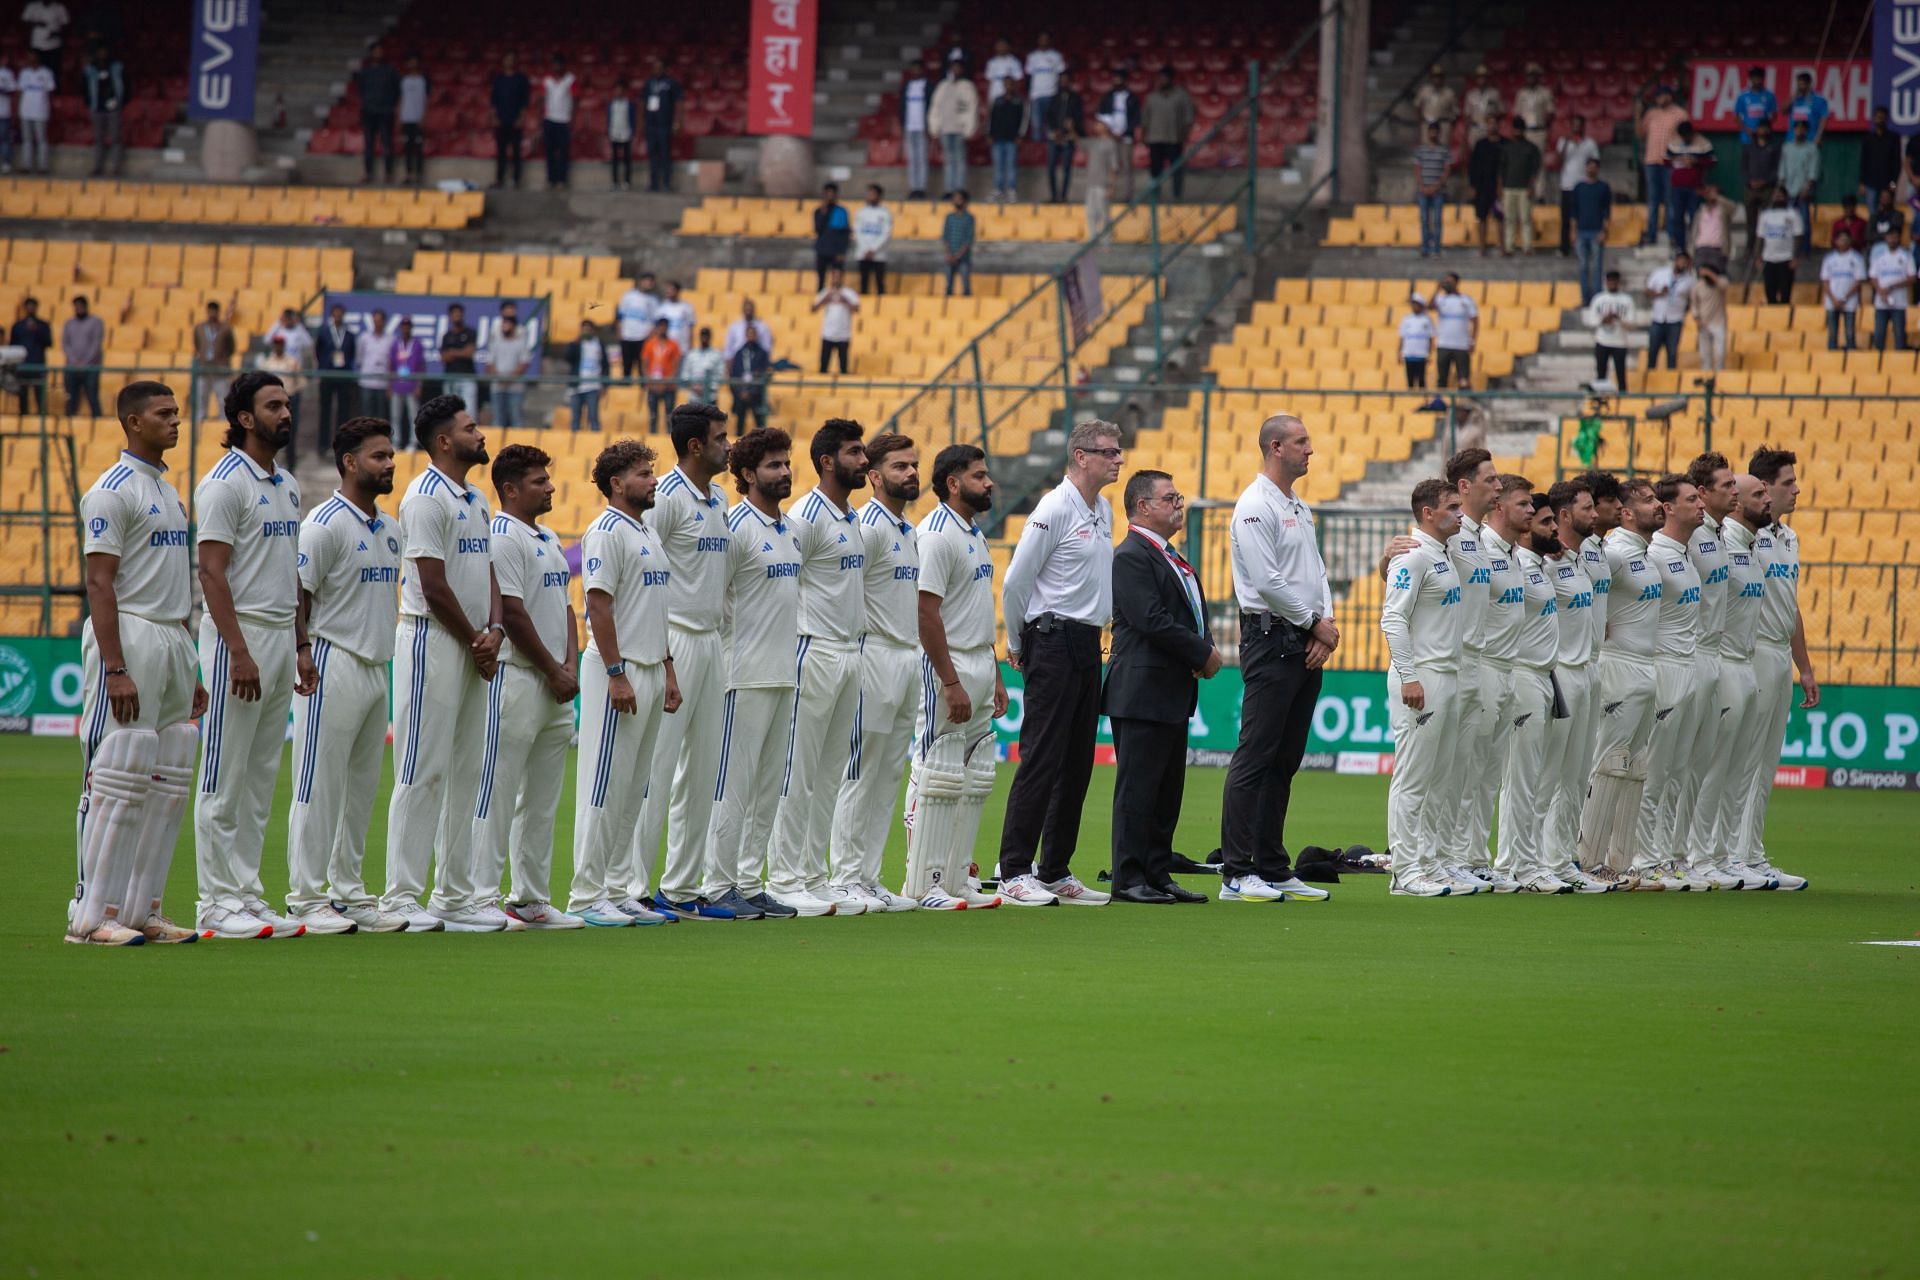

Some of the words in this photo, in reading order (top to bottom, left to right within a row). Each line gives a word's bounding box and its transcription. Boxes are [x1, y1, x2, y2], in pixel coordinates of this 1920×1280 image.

[1705, 564, 1728, 584] ANZ
[1497, 587, 1523, 603] ANZ
[1567, 592, 1592, 609] ANZ
[1677, 586, 1700, 604] ANZ
